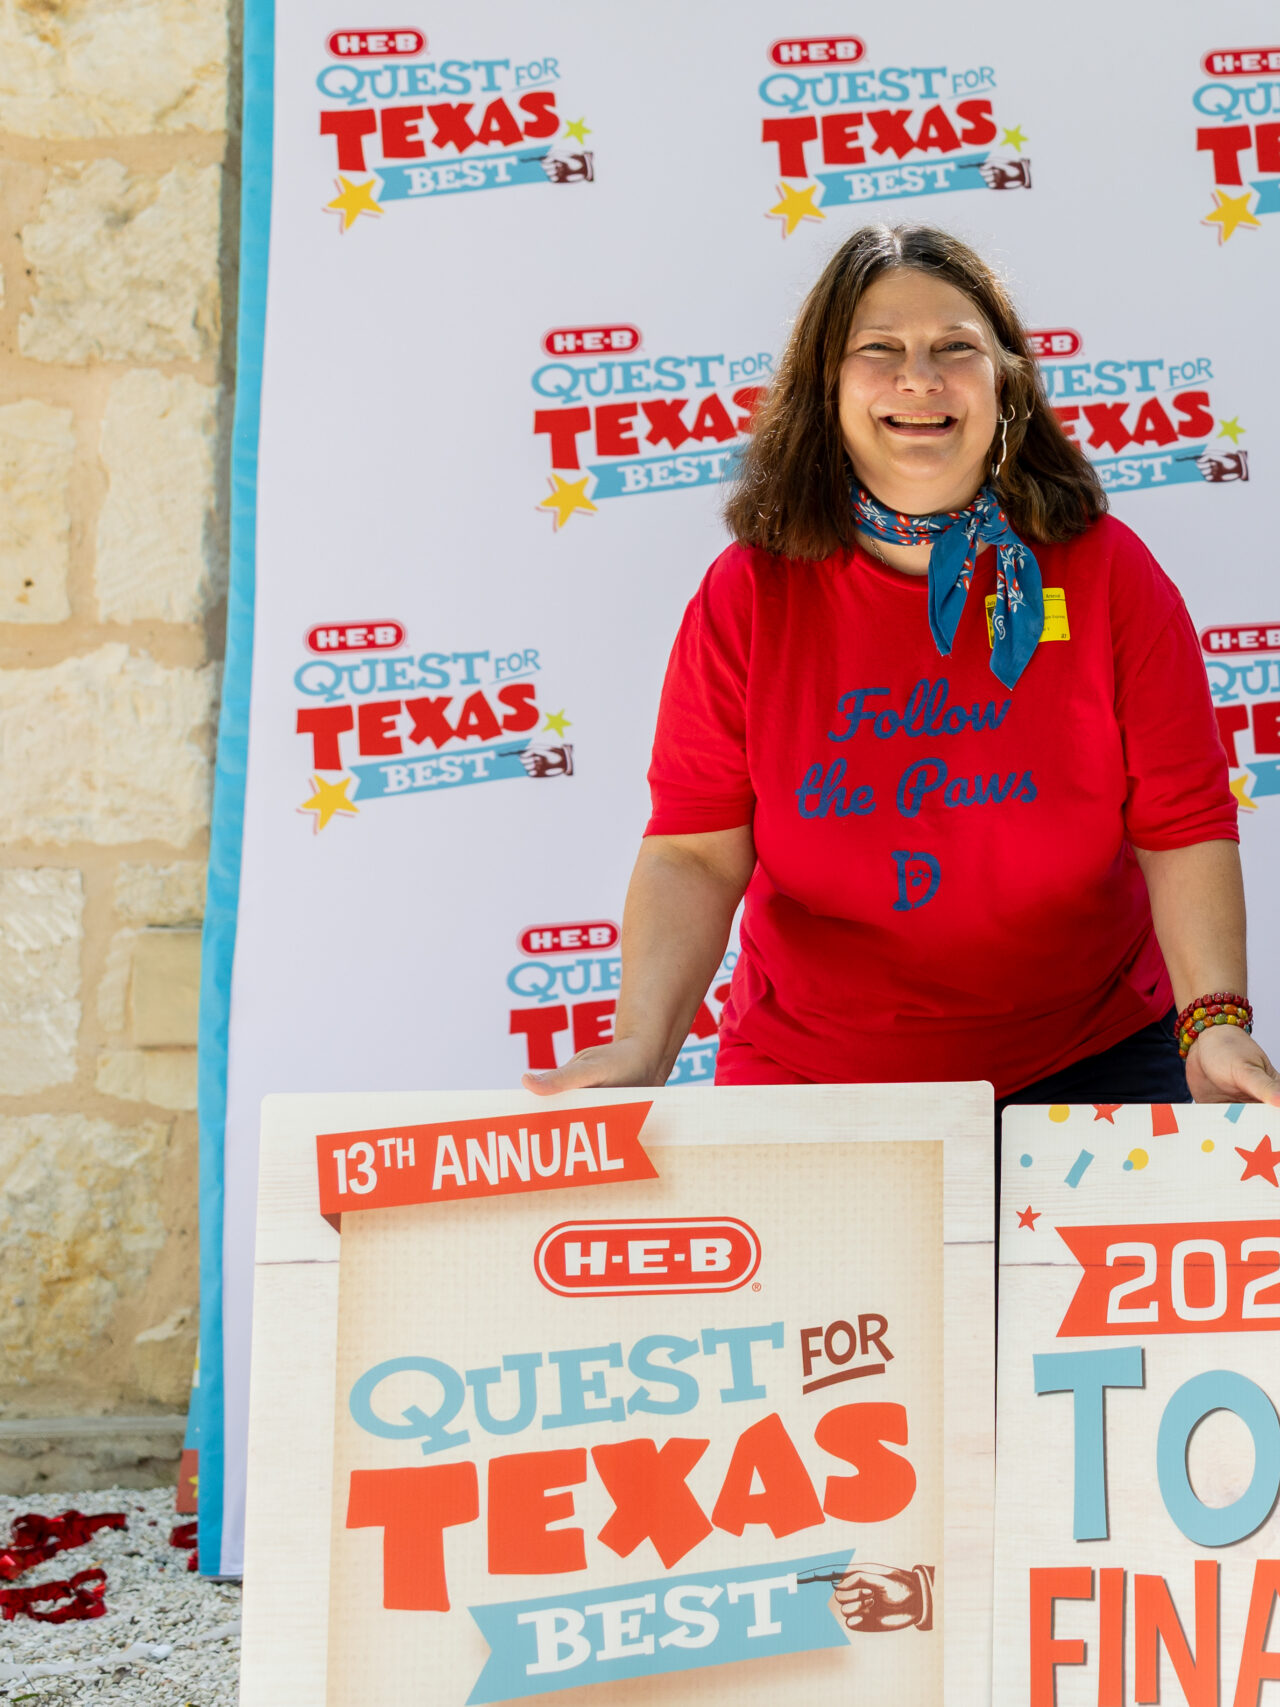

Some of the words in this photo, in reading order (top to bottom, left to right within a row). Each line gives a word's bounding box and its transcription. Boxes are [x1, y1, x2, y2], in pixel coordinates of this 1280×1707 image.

[316, 59, 510, 105] QUEST
[515, 58, 560, 86] FOR
[758, 66, 947, 113] QUEST
[952, 66, 996, 94] FOR
[320, 92, 560, 172] TEXAS
[762, 100, 997, 178] TEXAS
[403, 156, 518, 195] BEST
[845, 163, 956, 200] BEST
[531, 354, 724, 404] QUEST
[729, 352, 773, 382] FOR
[1169, 358, 1214, 387] FOR
[617, 451, 733, 493] BEST
[294, 651, 490, 703] QUEST
[495, 649, 541, 679] FOR
[297, 684, 540, 771] TEXAS
[827, 677, 1012, 742] Follow
[379, 751, 496, 793] BEST
[795, 757, 876, 819] the
[896, 757, 1038, 818] Paws
[506, 957, 622, 1003] QUE
[333, 1137, 416, 1195] 13TH
[432, 1121, 625, 1190] ANNUAL
[563, 1237, 734, 1277] H-E-B
[349, 1322, 784, 1456] QUEST
[800, 1313, 895, 1376] FOR
[346, 1402, 917, 1612] TEXAS
[517, 1573, 799, 1677] BEST
